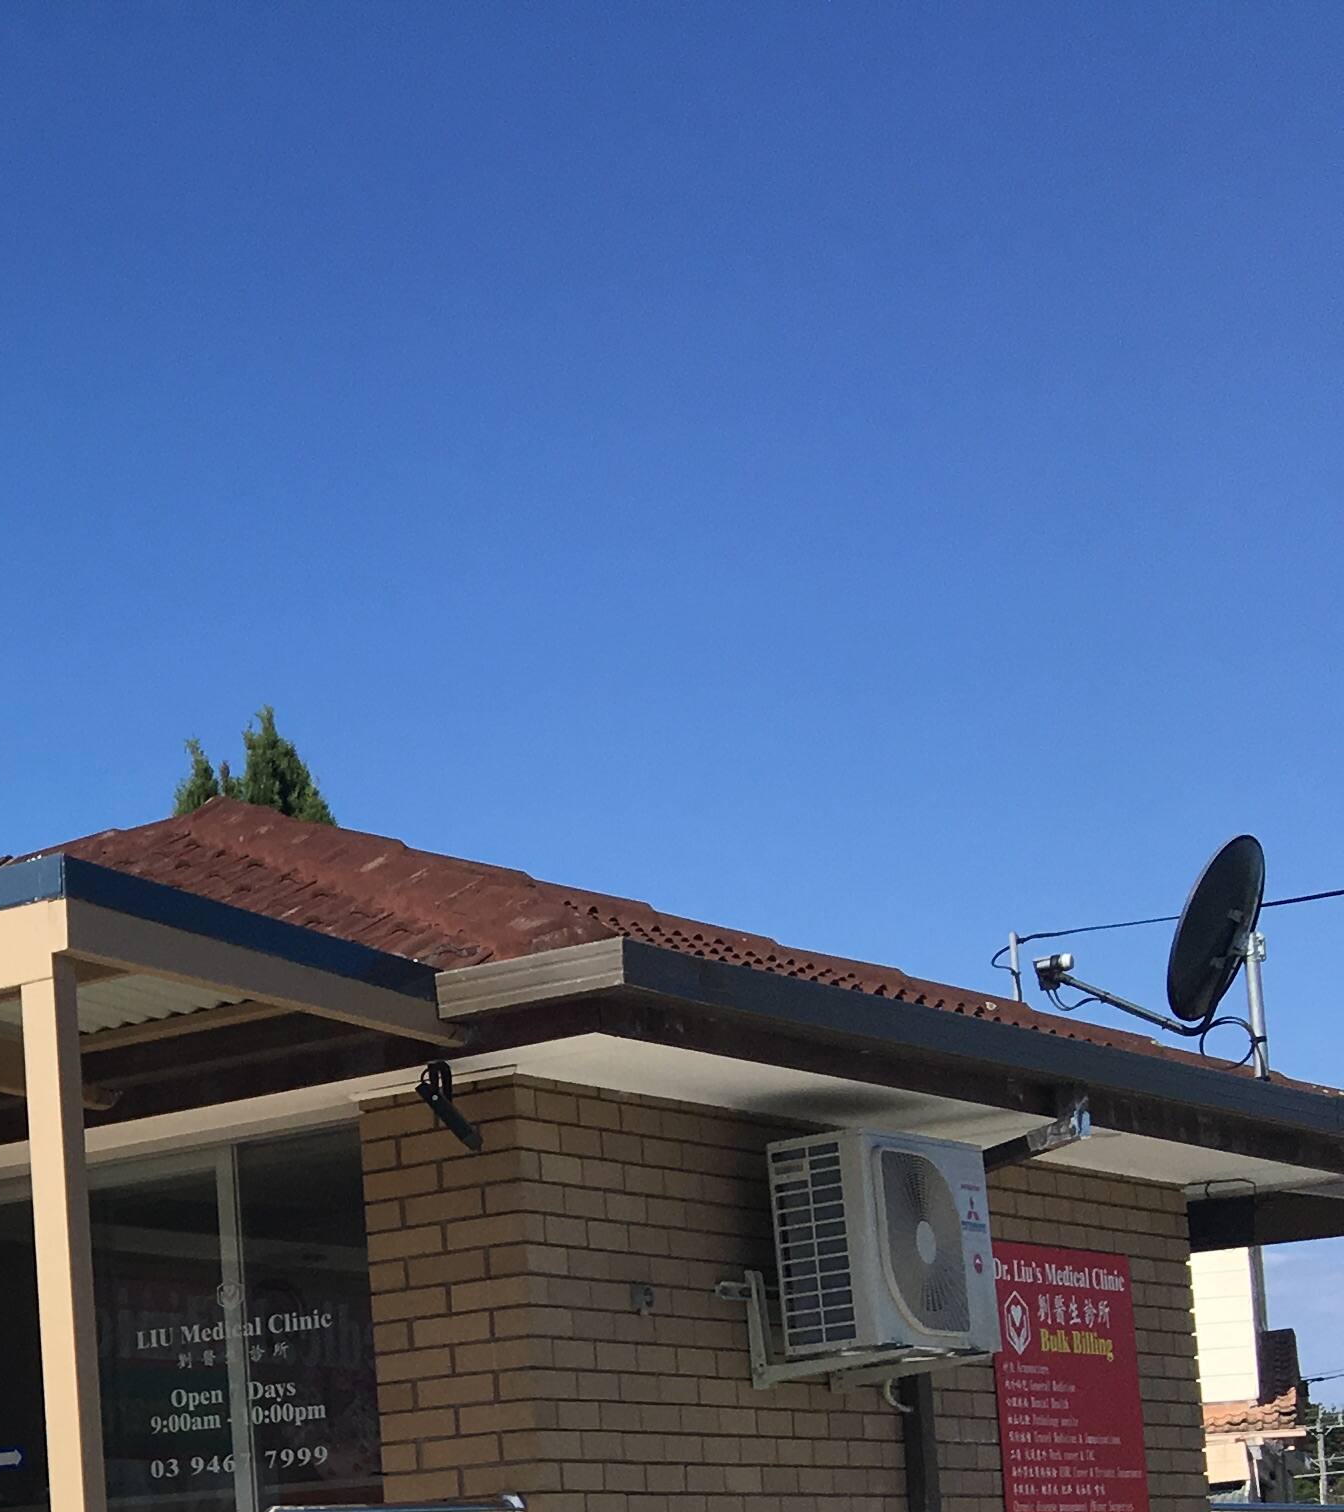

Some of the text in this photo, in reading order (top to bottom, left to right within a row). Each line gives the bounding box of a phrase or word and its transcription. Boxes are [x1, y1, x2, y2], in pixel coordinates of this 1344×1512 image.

[1013, 1259, 1043, 1284] Liu's
[1045, 1263, 1089, 1289] Medical
[1092, 1267, 1125, 1292] Clinic
[137, 1327, 174, 1350] LIU
[268, 1309, 334, 1335] Clinic
[1040, 1328, 1114, 1362] Bulk Billing
[170, 1381, 297, 1413] Open Days
[150, 1412, 222, 1435] 9:00am
[151, 1459, 180, 1480] 03
[264, 1446, 329, 1470] 7999
